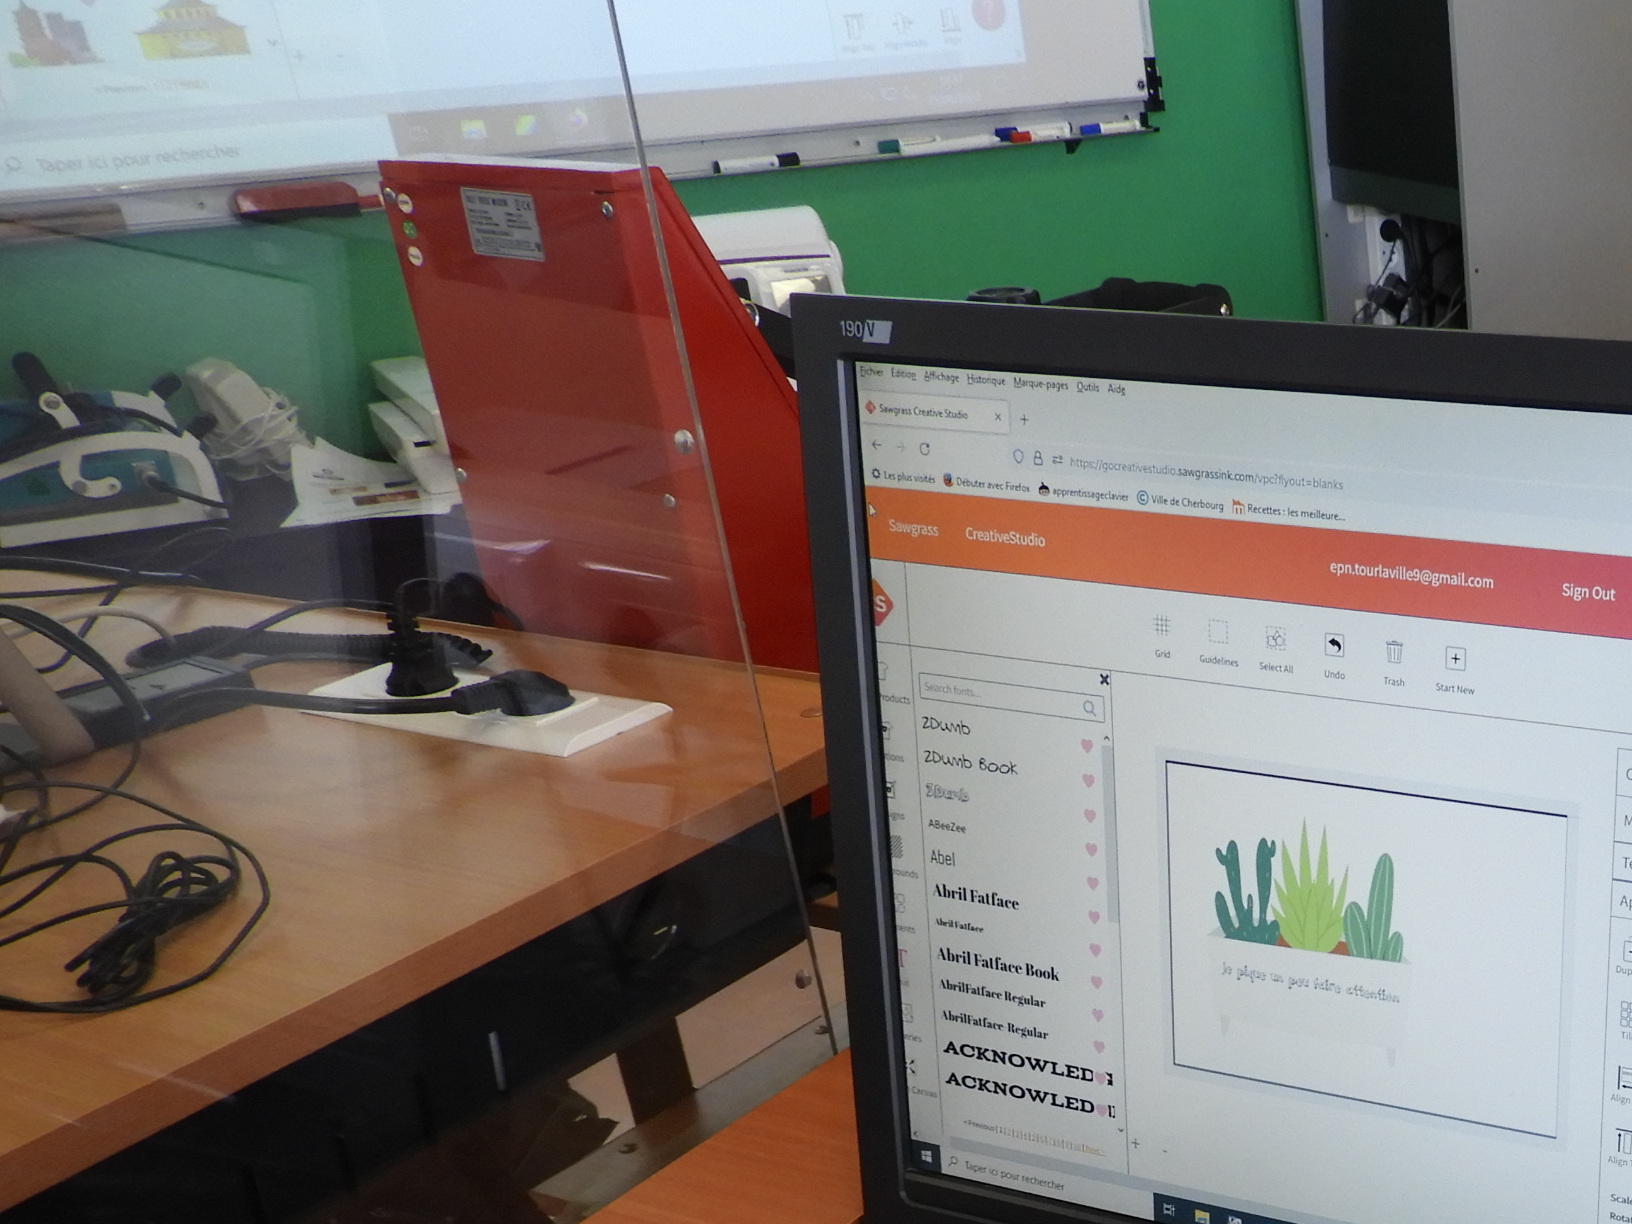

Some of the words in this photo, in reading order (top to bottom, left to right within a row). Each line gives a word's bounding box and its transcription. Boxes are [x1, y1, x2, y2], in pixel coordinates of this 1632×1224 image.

[860, 366, 884, 377] Fichier
[924, 371, 960, 384] Affichage
[966, 373, 1006, 388] Historique
[1013, 376, 1070, 391] Marque-pages
[1076, 381, 1100, 394] Outils
[1107, 383, 1126, 396] Aide
[879, 403, 912, 418] Sawgrass
[913, 406, 944, 418] Creative
[944, 408, 968, 420] Studio
[884, 471, 896, 482] Les
[897, 473, 912, 485] plus
[986, 481, 1004, 491] avec
[1005, 481, 1031, 493] Firefox
[1052, 487, 1129, 503] apprentissageclavier
[1151, 494, 1169, 506] Ville
[1170, 497, 1181, 507] de
[1181, 498, 1224, 513] Cherbourg
[1287, 507, 1299, 518] les
[888, 518, 939, 538] Sawgrass
[1329, 559, 1494, 590] epn.tourlaville9@gmail.com
[1562, 583, 1590, 601] Sign
[1592, 586, 1616, 602] Out
[1155, 649, 1171, 660] Grid
[1199, 653, 1239, 668] Guidelines
[1258, 661, 1282, 674] Select
[1283, 664, 1294, 675] All
[1324, 669, 1346, 681] Undo
[923, 681, 952, 696] Search
[1383, 676, 1406, 688] Trash
[1435, 682, 1456, 694] Start
[1456, 685, 1476, 696] New
[930, 849, 957, 868] Abel
[932, 883, 968, 902] Abril
[969, 889, 1020, 911] Fatface
[936, 947, 971, 966] Abril
[973, 954, 1023, 976] Fatface
[1024, 962, 1060, 982] Book
[1003, 991, 1046, 1009] Regular
[1610, 1093, 1631, 1106] Align
[1607, 1155, 1629, 1169] Align
[964, 1159, 988, 1174] Taper
[1000, 1170, 1020, 1182] pour
[1021, 1174, 1065, 1191] rechercher
